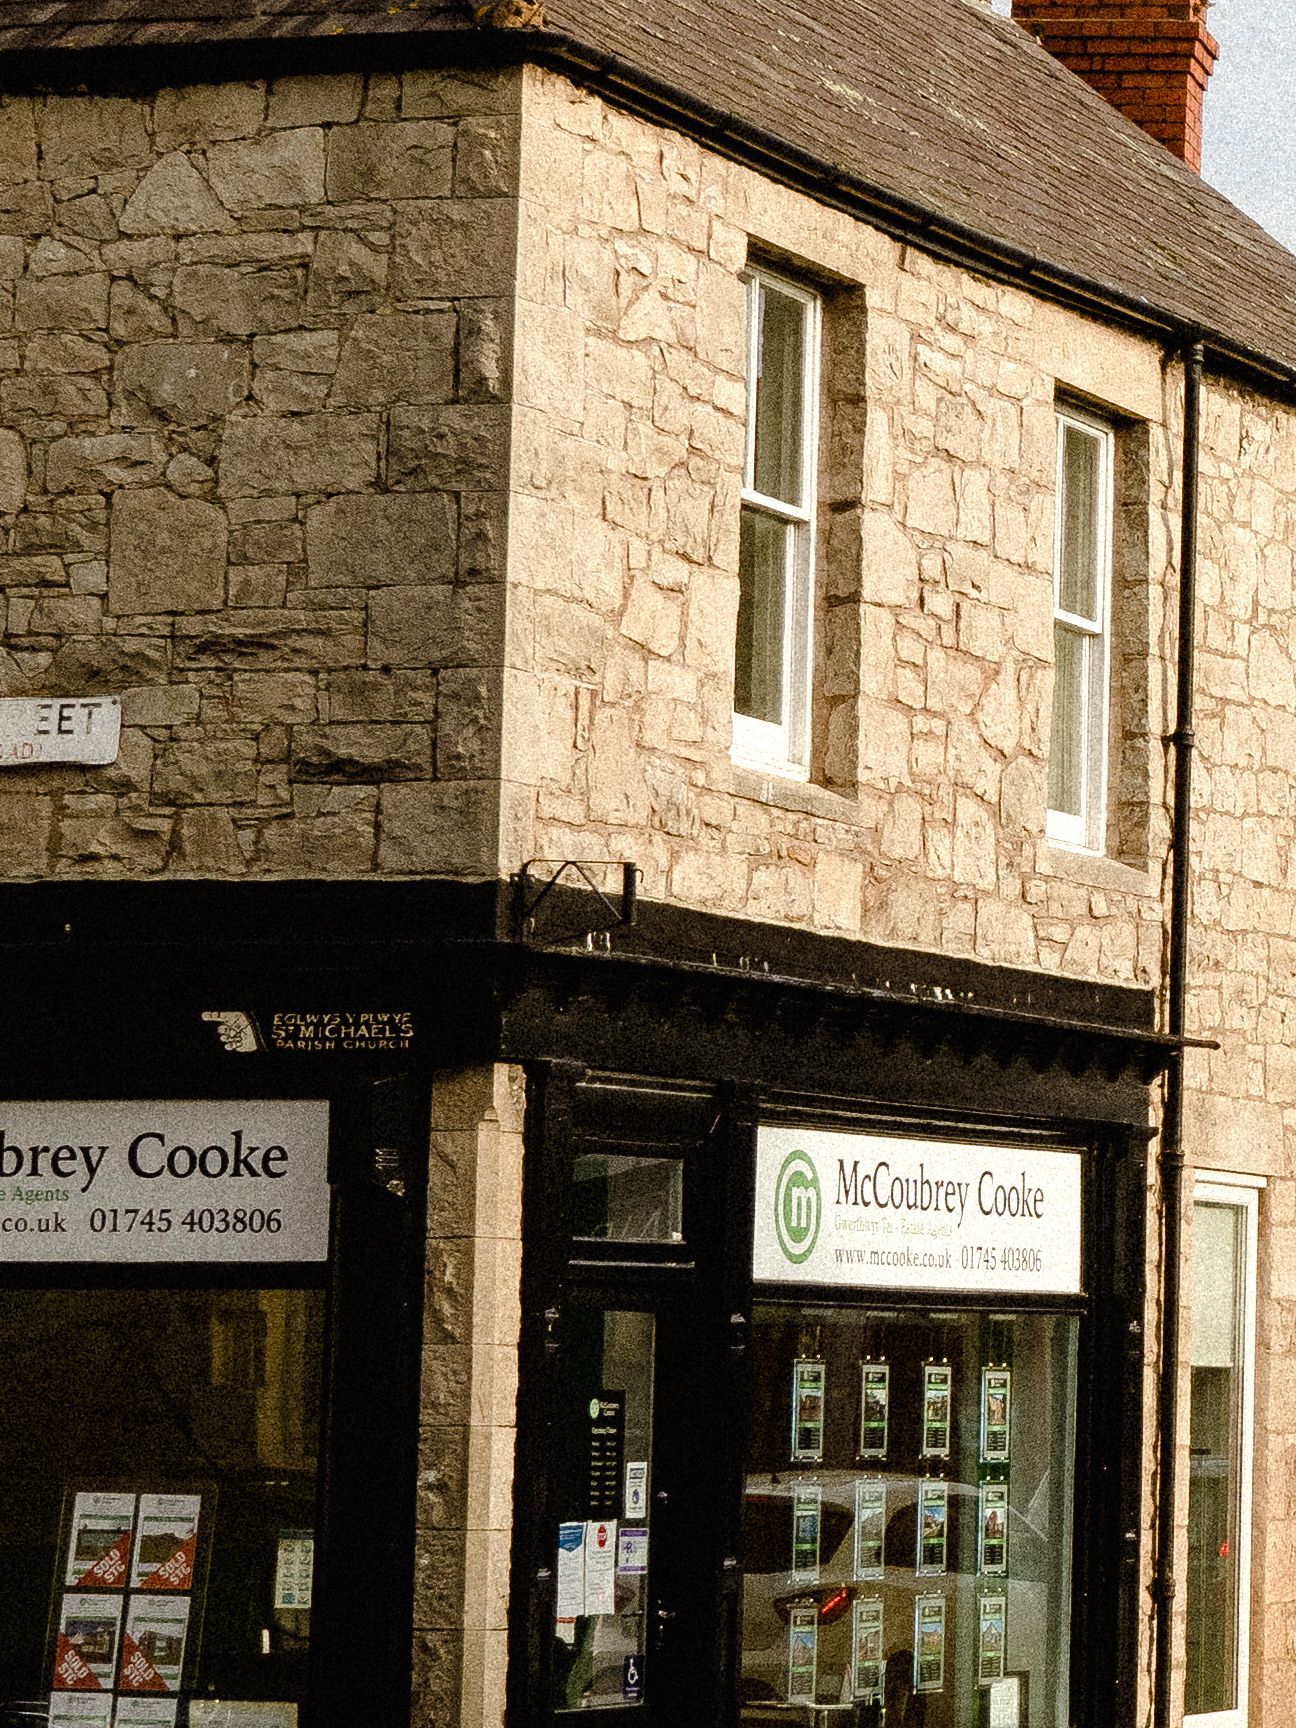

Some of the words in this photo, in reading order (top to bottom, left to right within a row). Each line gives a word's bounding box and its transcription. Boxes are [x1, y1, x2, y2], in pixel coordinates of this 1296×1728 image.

[273, 1013, 341, 1025] EGLWYS
[299, 1024, 414, 1038] MICHAEL'S
[275, 1039, 335, 1051] PARISH
[343, 1039, 409, 1050] CHURCH
[127, 1129, 290, 1179] Cooke
[11, 1186, 70, 1205] Agents
[834, 1158, 970, 1229] McCoubrey
[977, 1170, 1045, 1219] Cooke
[89, 1208, 173, 1234] 01745
[181, 1208, 283, 1234] 403806
[834, 1245, 952, 1270] www.mccooke.co.uk
[961, 1244, 997, 1270] 01745
[1000, 1246, 1043, 1273] 403806
[93, 1548, 121, 1578] SOLD
[157, 1551, 187, 1579] SOLD
[64, 1649, 90, 1679] SOLD
[130, 1651, 155, 1681] SOLD
